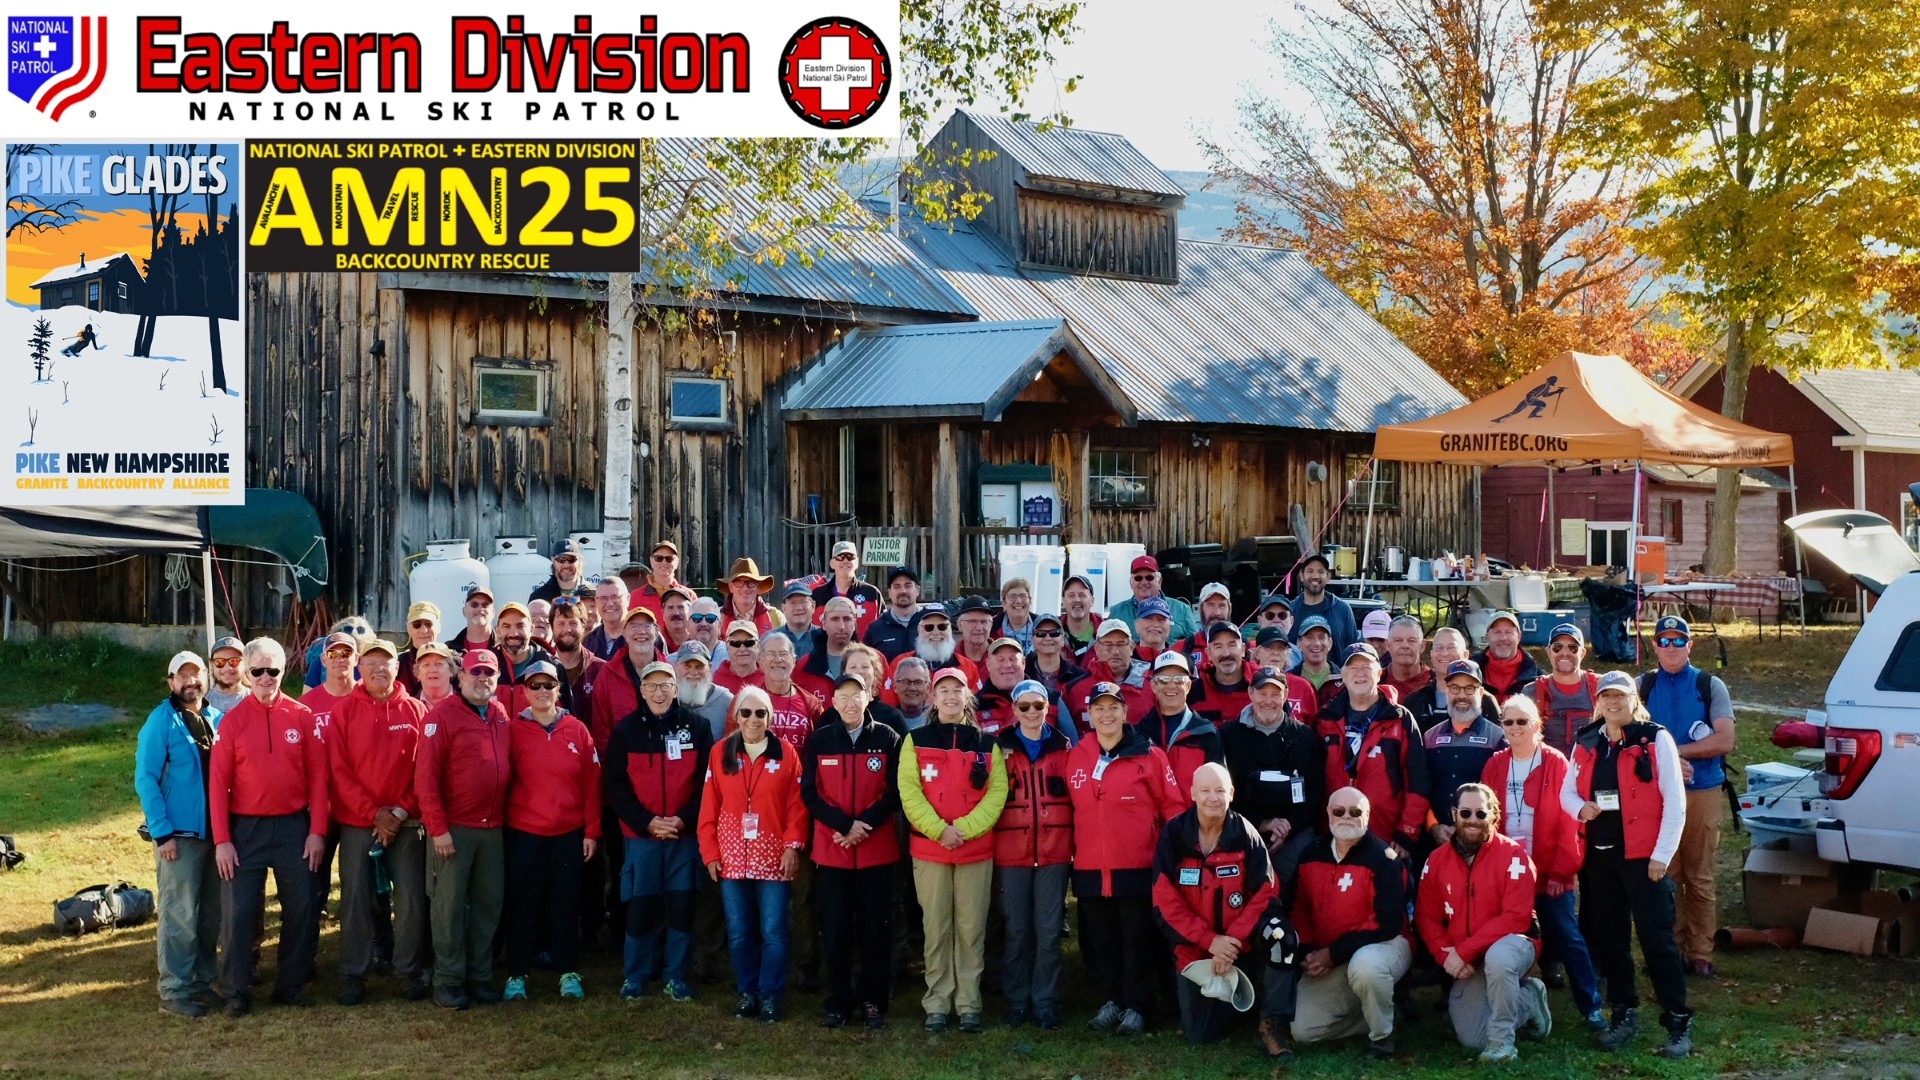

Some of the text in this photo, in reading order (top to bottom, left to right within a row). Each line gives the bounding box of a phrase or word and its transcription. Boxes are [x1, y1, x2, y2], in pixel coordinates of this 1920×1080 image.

[1440, 433, 1568, 452] GRANITEBC.ORG
[869, 539, 901, 550] VISITOR
[866, 551, 901, 562] PARKING
[1143, 600, 1166, 609] NASA
